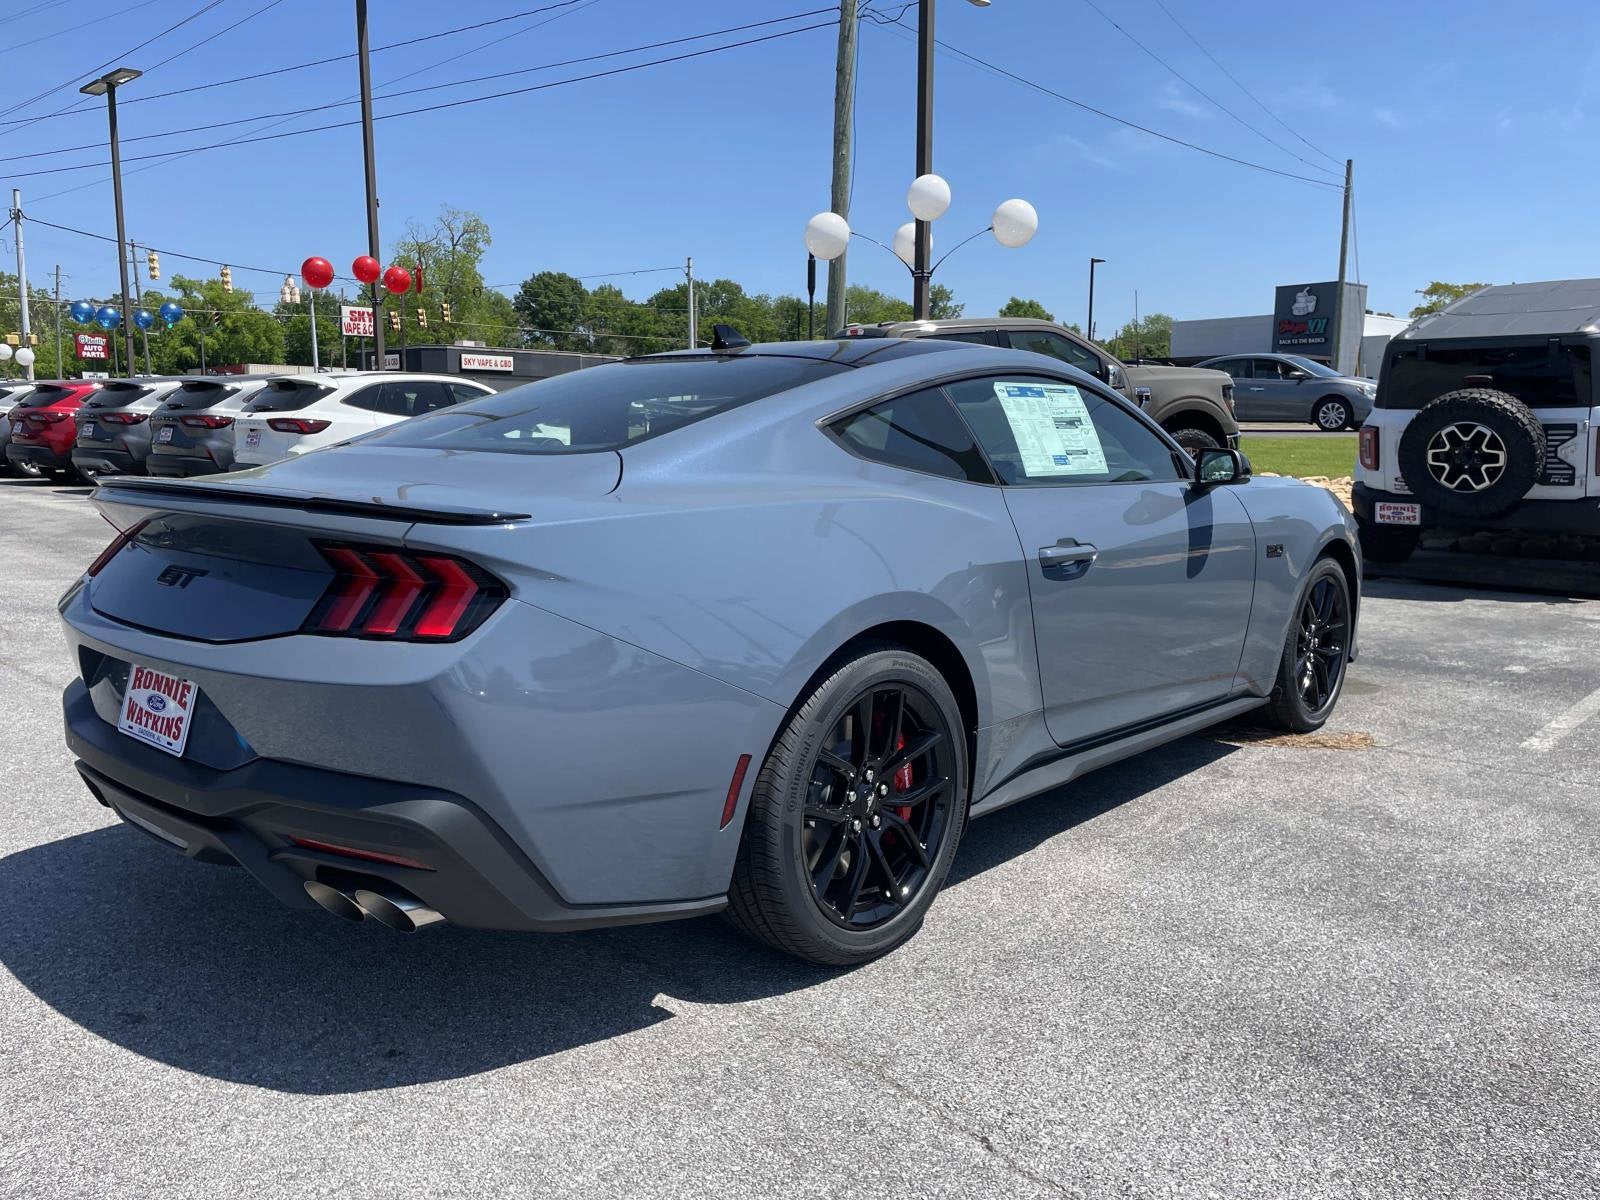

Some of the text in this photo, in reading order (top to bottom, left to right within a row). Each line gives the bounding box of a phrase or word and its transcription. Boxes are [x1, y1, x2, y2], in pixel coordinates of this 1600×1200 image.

[349, 310, 374, 323] SKY
[344, 322, 361, 335] VAPE
[362, 323, 368, 335] &
[463, 357, 476, 366] SKY
[477, 358, 493, 367] VAPE
[500, 360, 512, 368] CBD
[1379, 504, 1417, 513] RONNIE
[1379, 513, 1417, 521] WATKINS
[157, 564, 210, 589] GT
[131, 667, 192, 711] RONNIE
[126, 696, 184, 741] WATKINS
